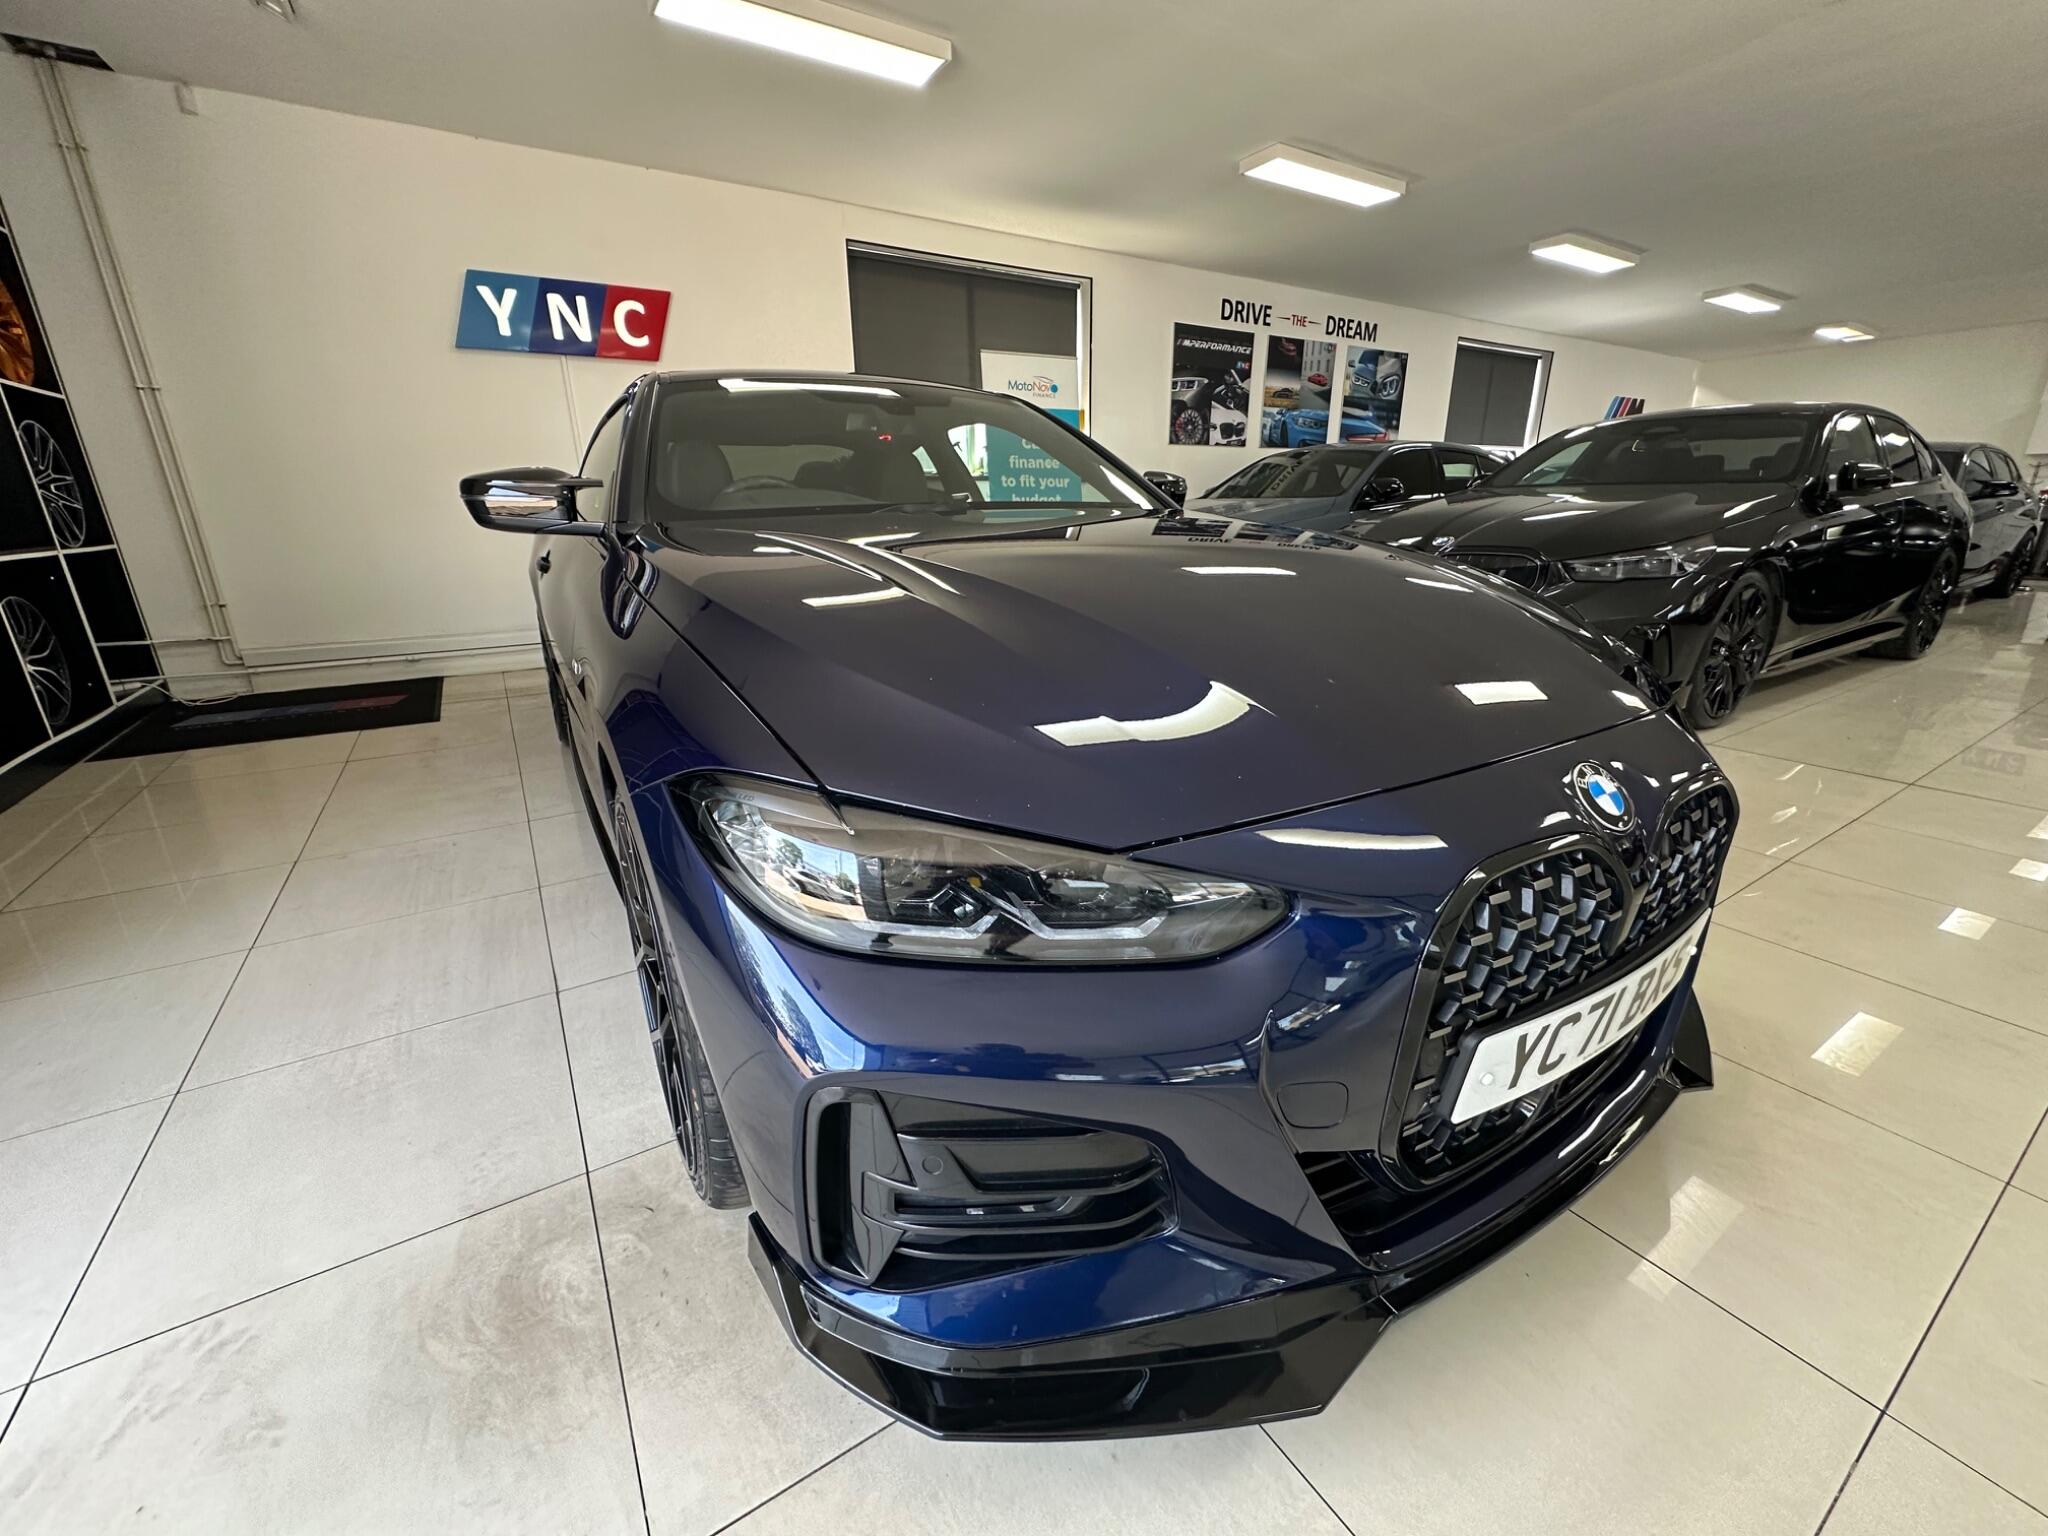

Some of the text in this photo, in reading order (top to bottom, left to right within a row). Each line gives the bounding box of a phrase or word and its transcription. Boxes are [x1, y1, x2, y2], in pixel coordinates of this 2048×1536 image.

[475, 285, 650, 348] YNC
[1220, 298, 1379, 343] DRIVE THE DREAM
[1001, 475, 1071, 490] to fit your
[1009, 455, 1061, 469] finance
[1507, 986, 1627, 1090] YC71
